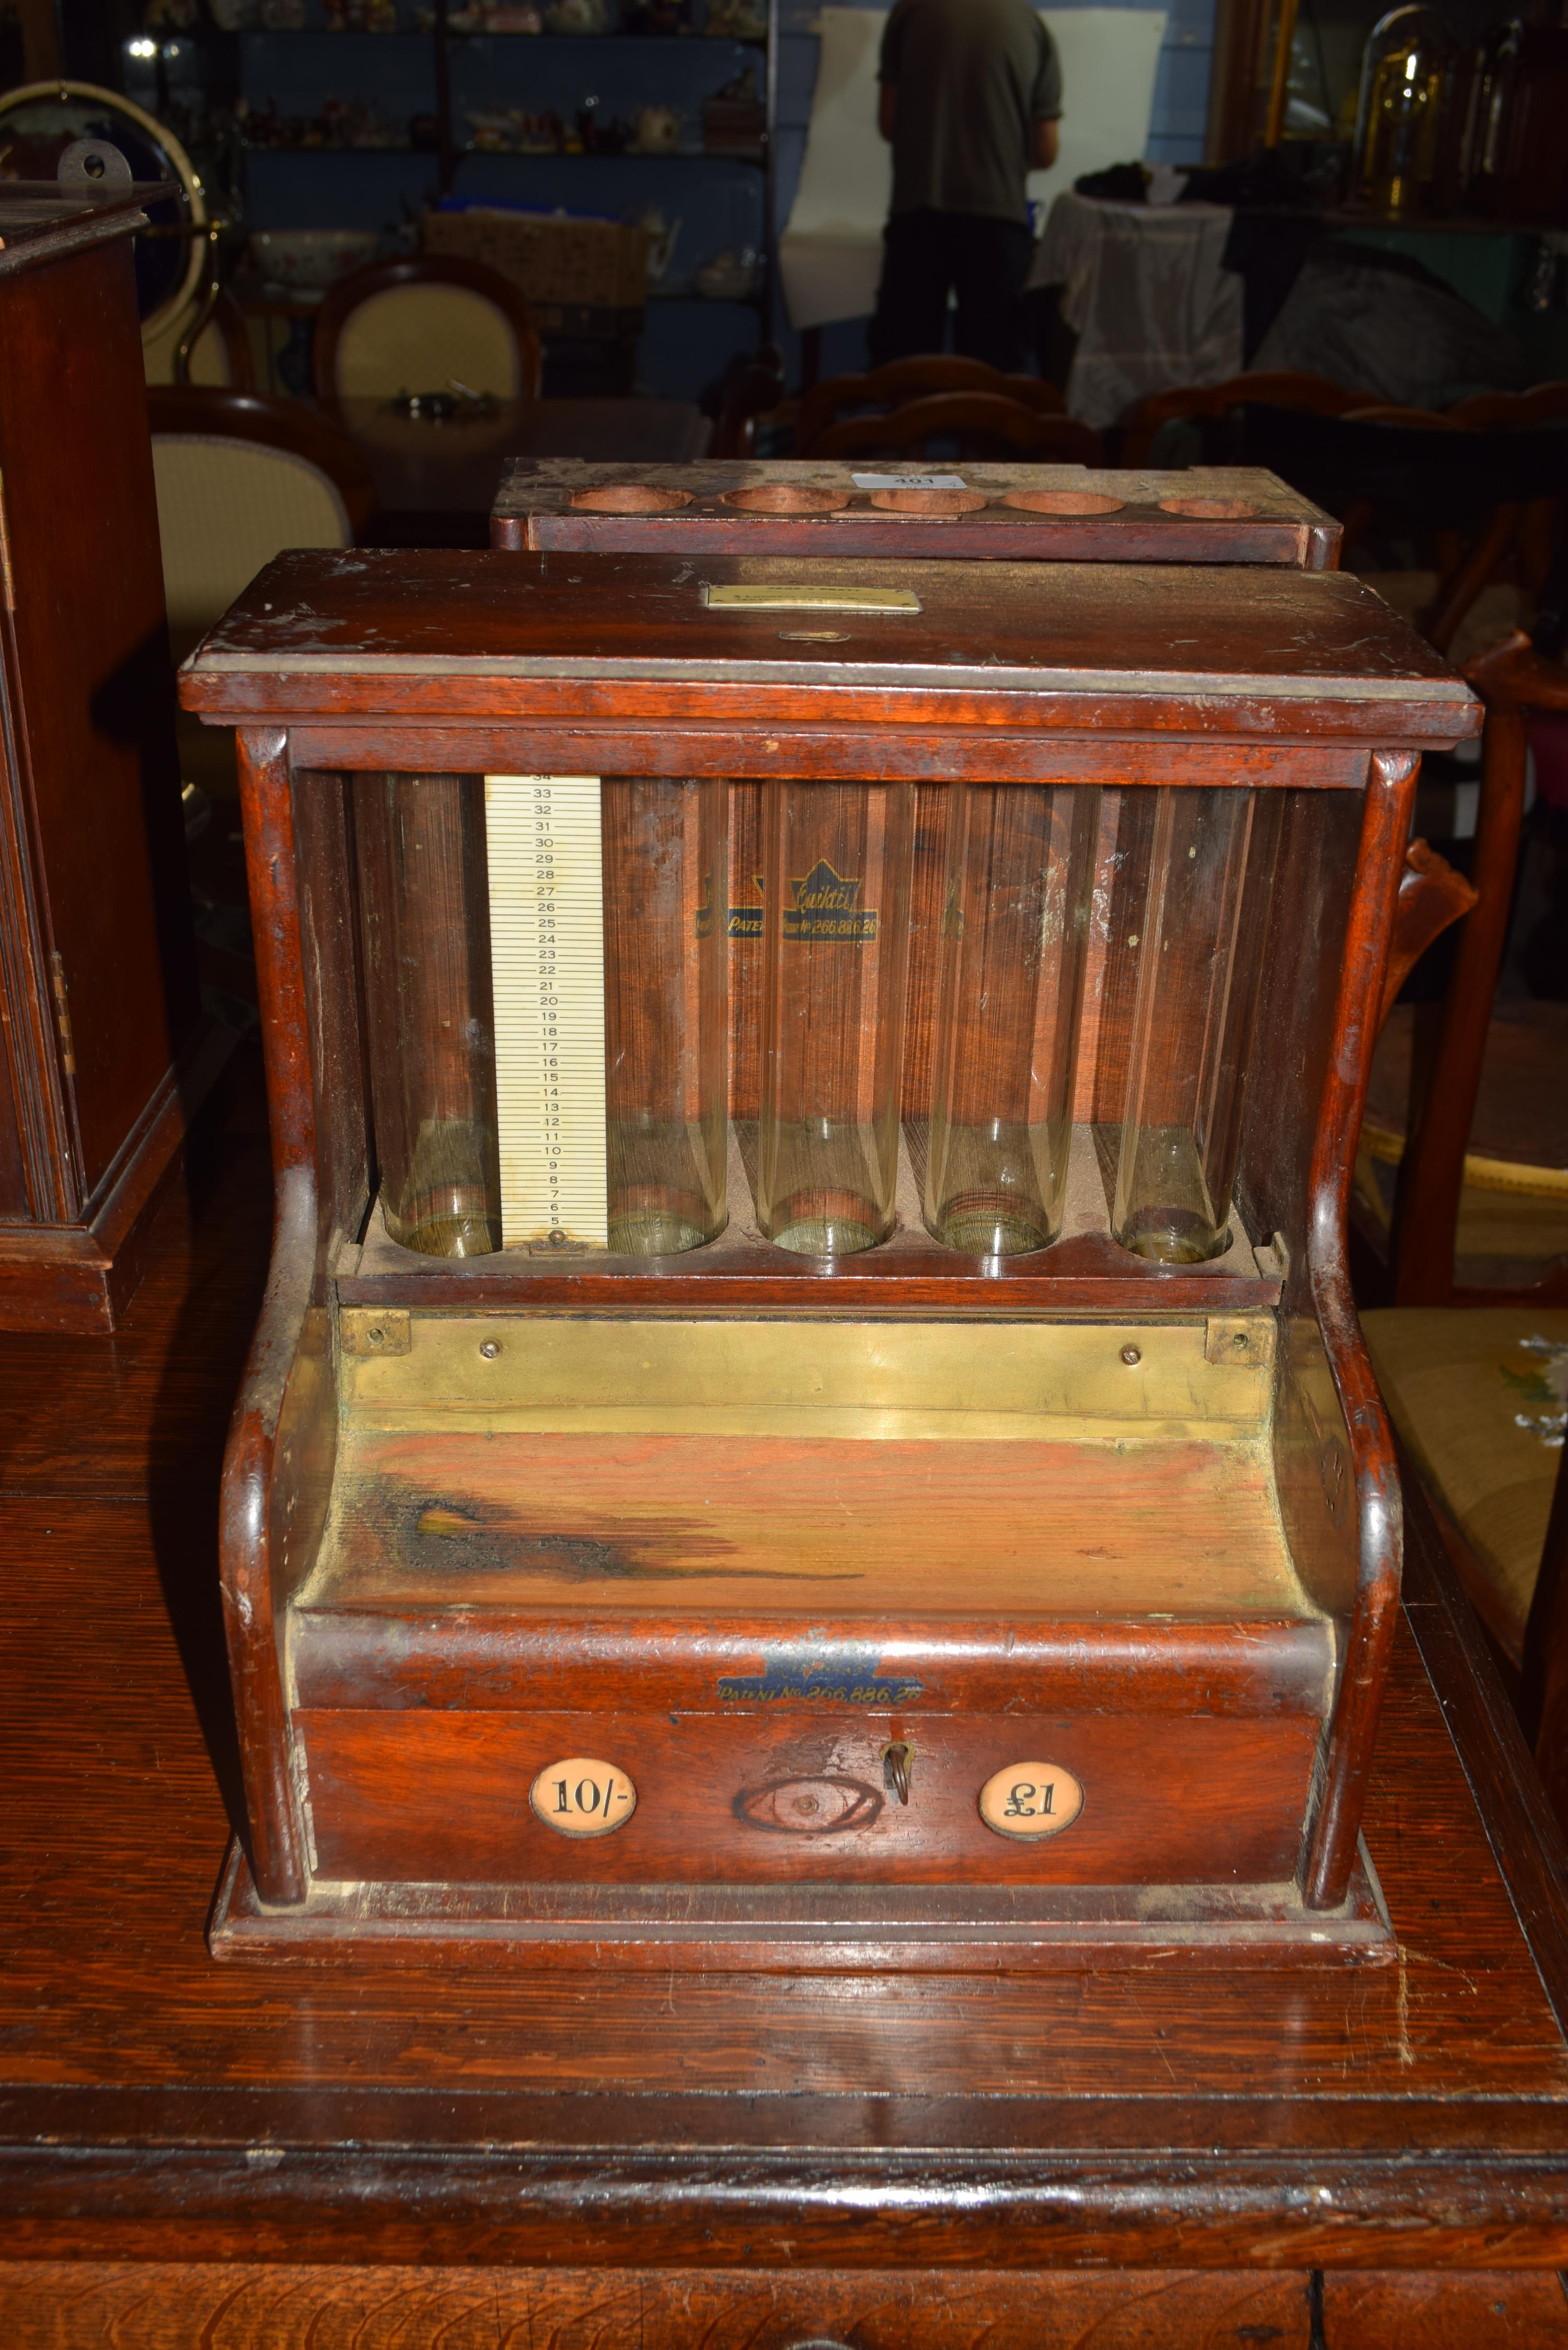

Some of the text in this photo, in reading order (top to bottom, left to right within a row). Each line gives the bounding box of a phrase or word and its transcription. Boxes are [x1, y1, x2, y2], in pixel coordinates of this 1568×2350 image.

[534, 789, 550, 798] 33
[535, 805, 551, 814] 32
[536, 822, 549, 831] 31
[536, 838, 553, 847] 30
[536, 855, 553, 863] 29
[537, 887, 554, 895] 27
[538, 903, 555, 912] 26
[539, 950, 555, 959] 23
[552, 1779, 628, 1817] 10/-
[1004, 1783, 1056, 1816] £1
